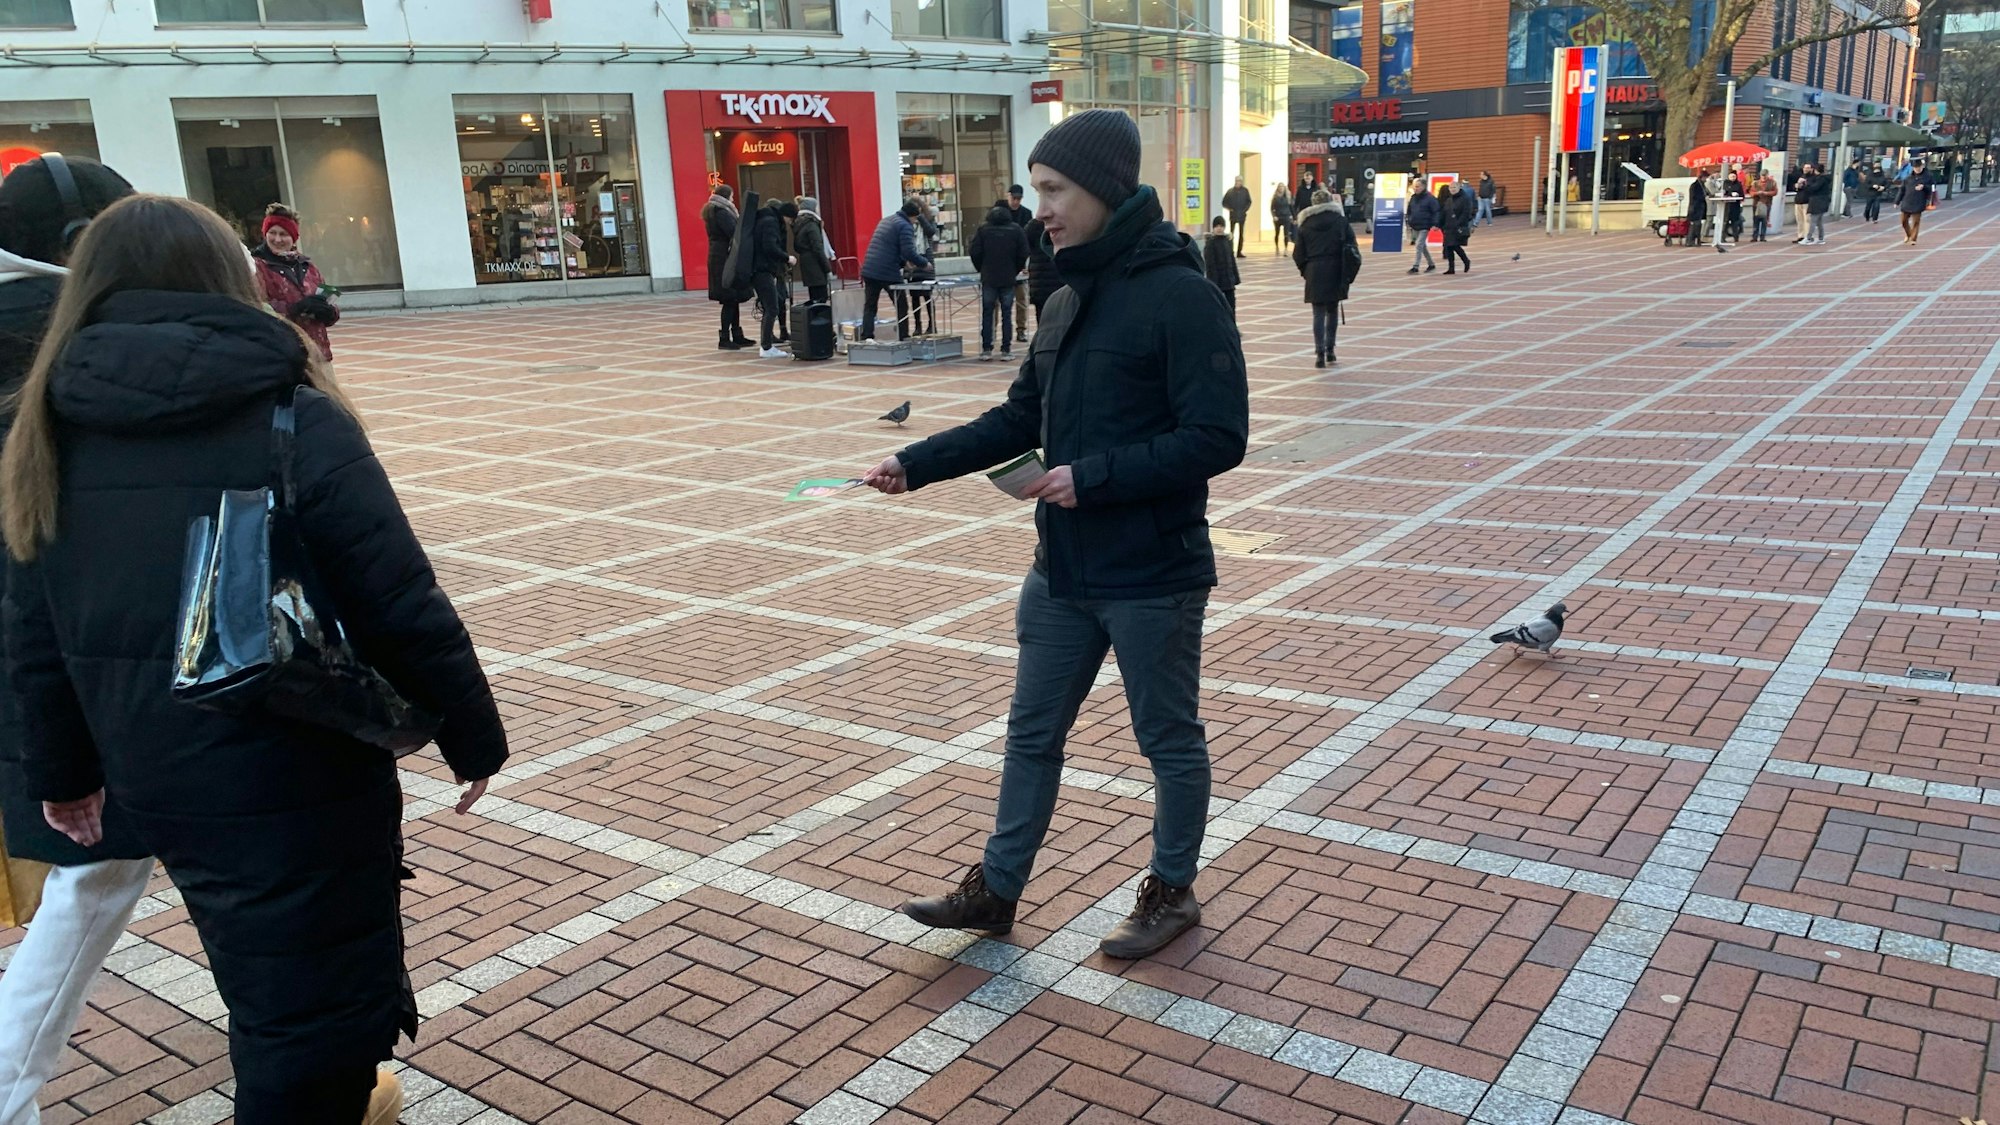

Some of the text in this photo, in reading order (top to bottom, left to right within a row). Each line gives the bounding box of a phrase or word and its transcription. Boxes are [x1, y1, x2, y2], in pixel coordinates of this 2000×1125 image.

[1605, 84, 1648, 103] HAUS
[1332, 99, 1402, 124] REWE
[742, 141, 784, 155] Aufzug
[1721, 155, 1744, 163] SPD
[485, 262, 536, 273] TKMAXX.DE
